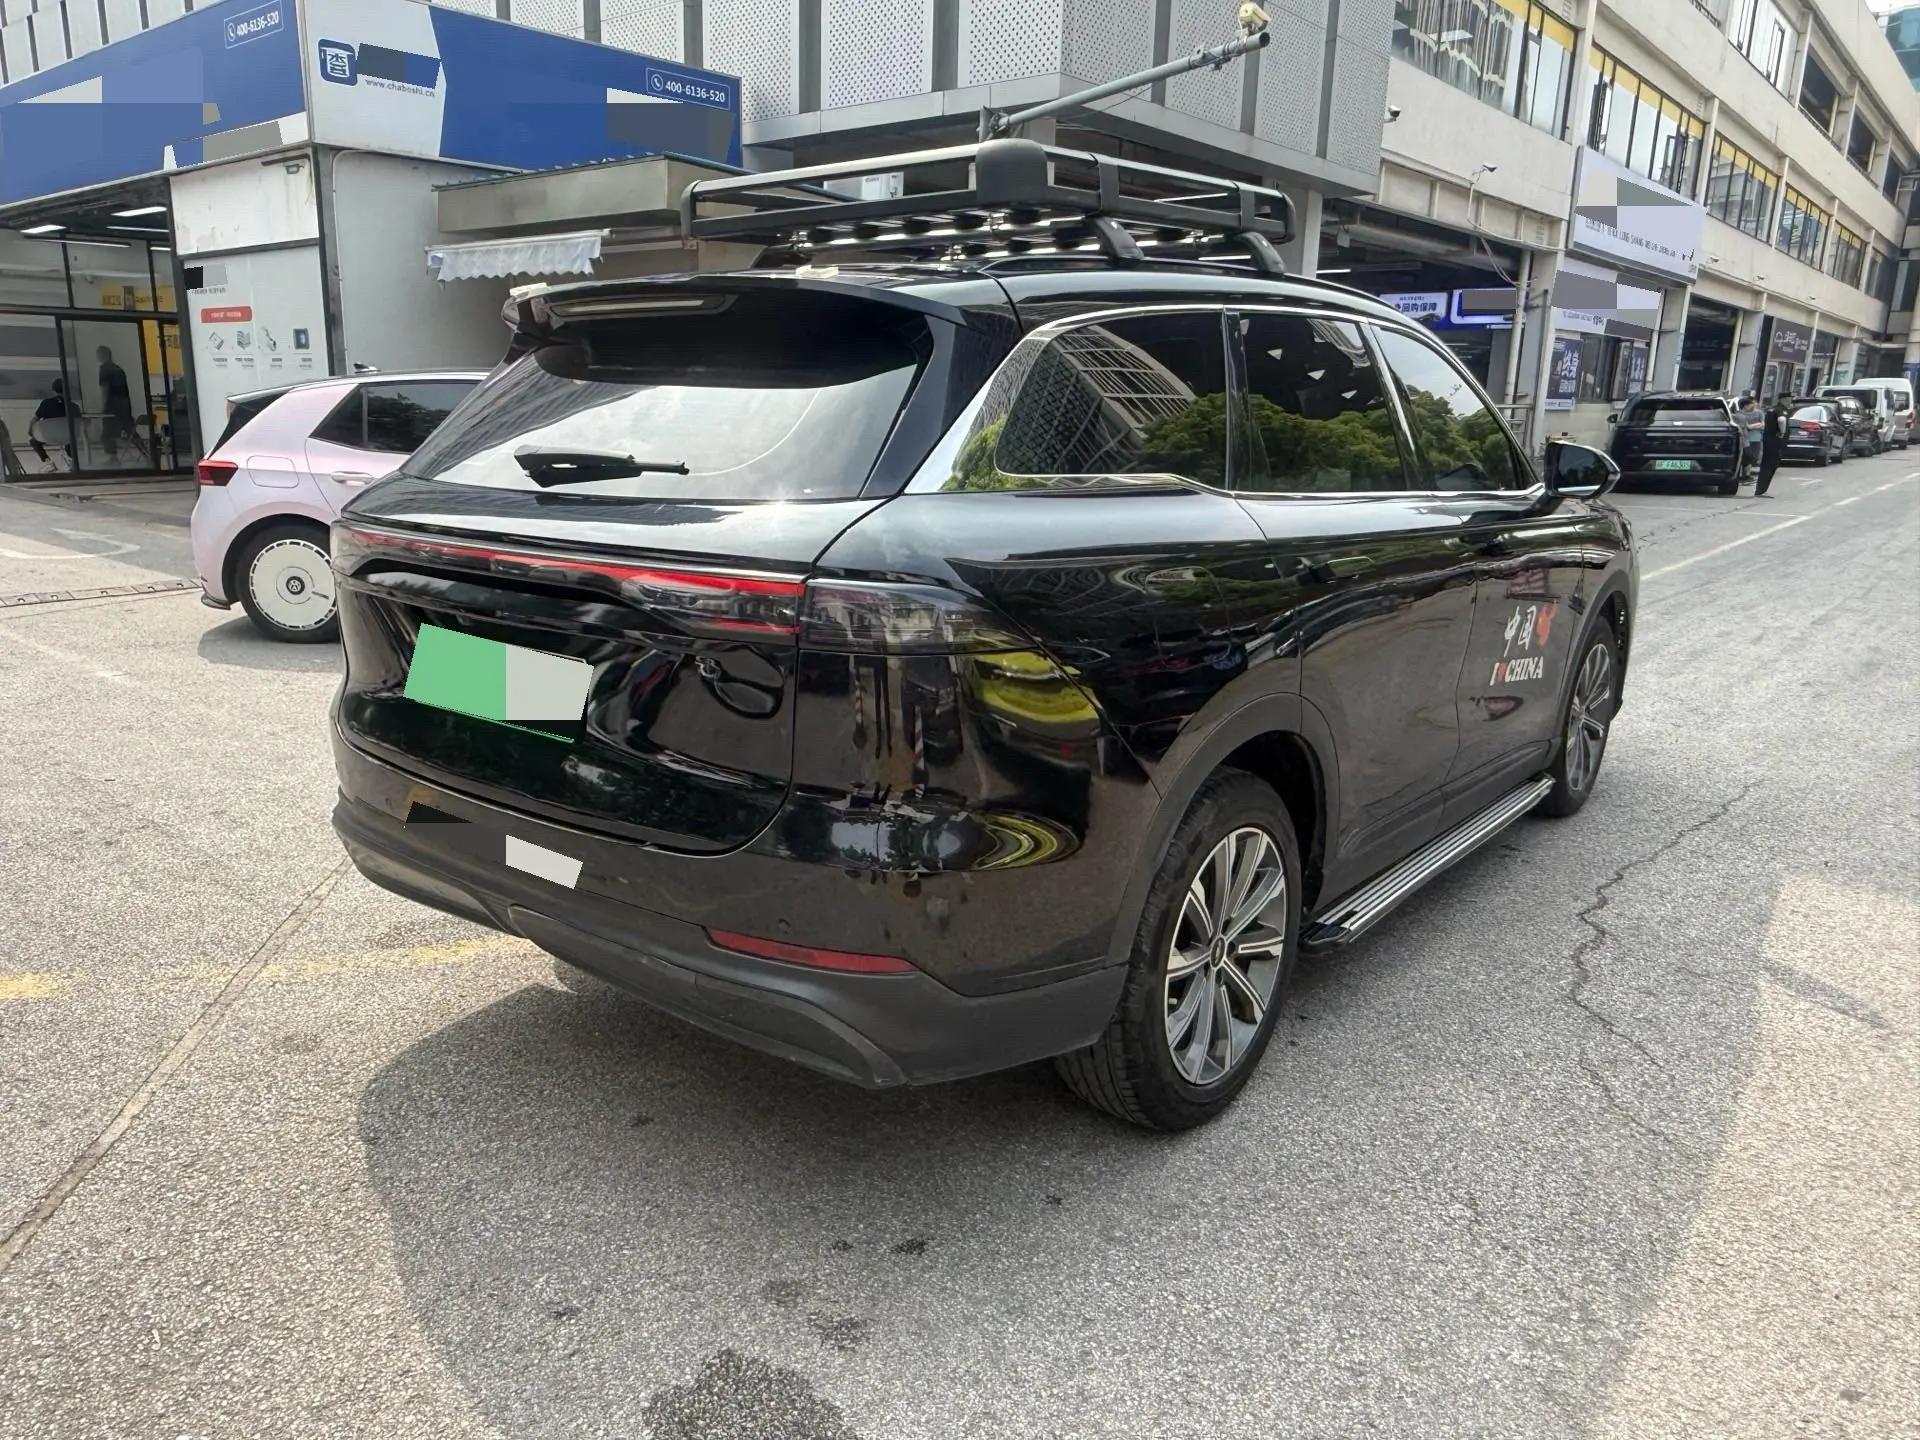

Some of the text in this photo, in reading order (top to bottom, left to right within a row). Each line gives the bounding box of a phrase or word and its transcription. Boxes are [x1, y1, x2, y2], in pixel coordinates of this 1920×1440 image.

[236, 10, 280, 36] 400-6136-520
[319, 46, 354, 78] 查
[364, 78, 436, 98] www.chaboshi.cn
[665, 80, 726, 103] 400-6136-520
[1504, 656, 1544, 682] CHINA
